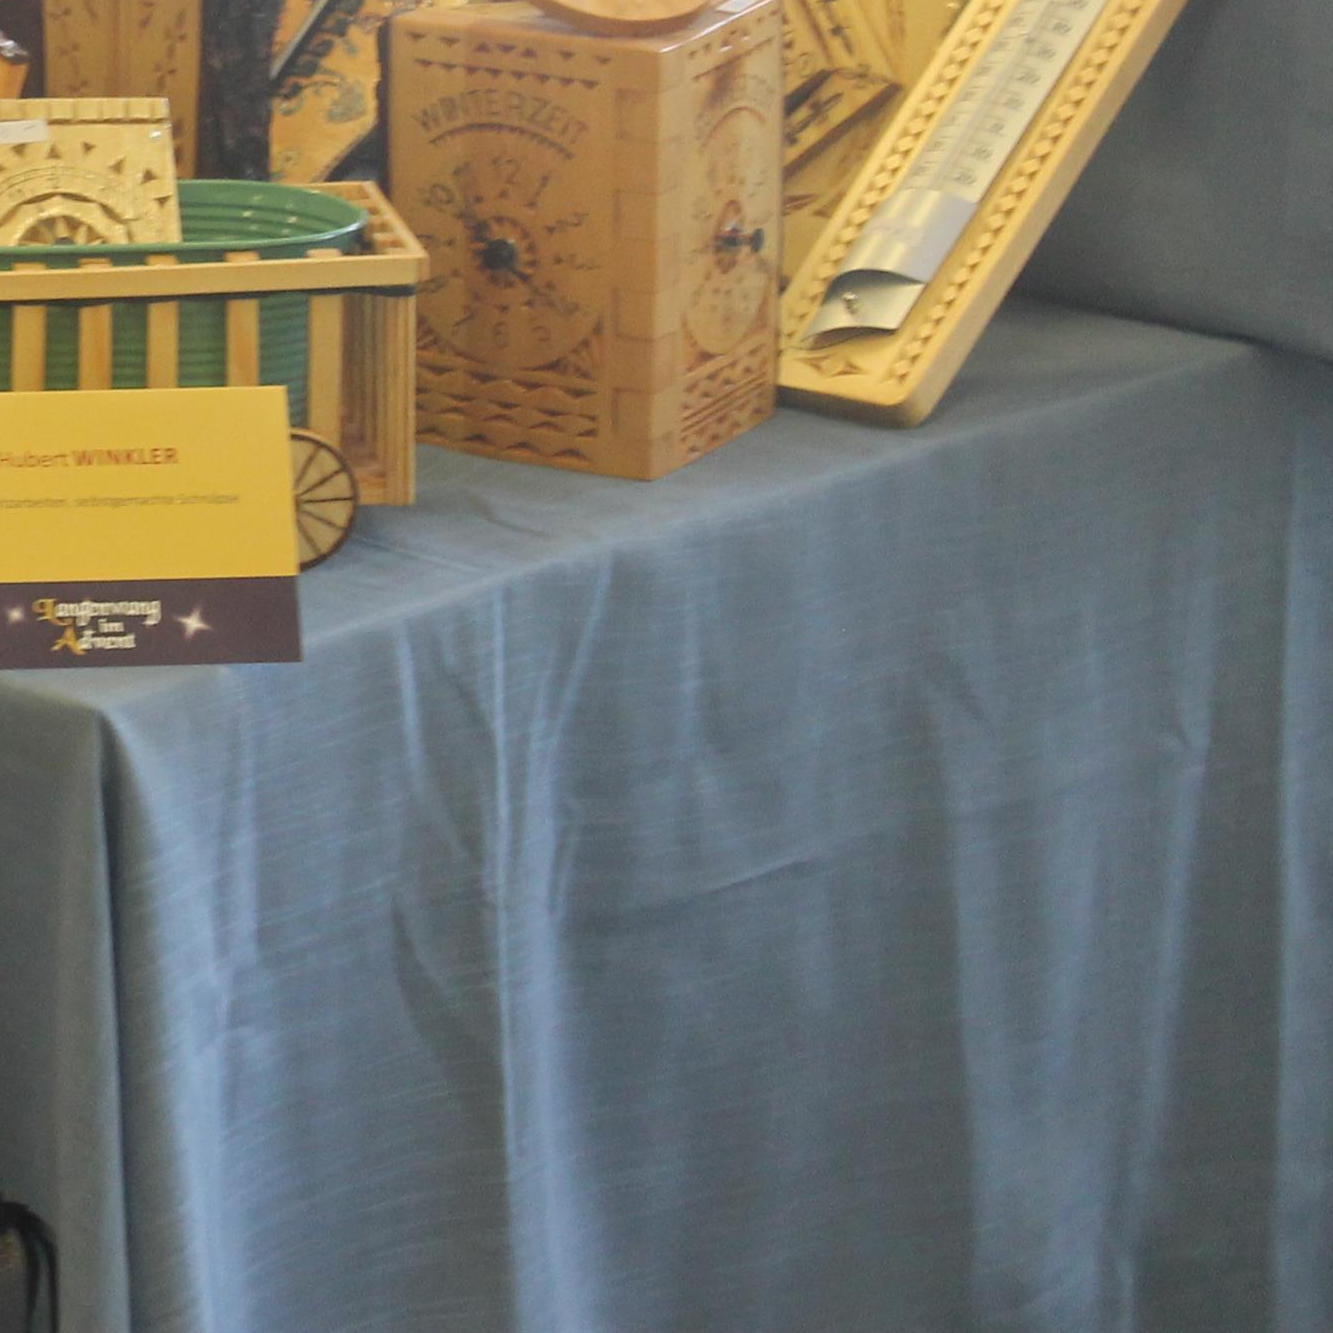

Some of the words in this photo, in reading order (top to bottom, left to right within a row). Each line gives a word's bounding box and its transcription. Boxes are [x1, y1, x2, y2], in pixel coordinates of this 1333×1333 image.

[411, 88, 590, 144] WINTERZEIT
[72, 447, 179, 467] WINKLER
[32, 598, 162, 627] Langenwang
[97, 617, 125, 633] im
[51, 626, 137, 656] Advent
